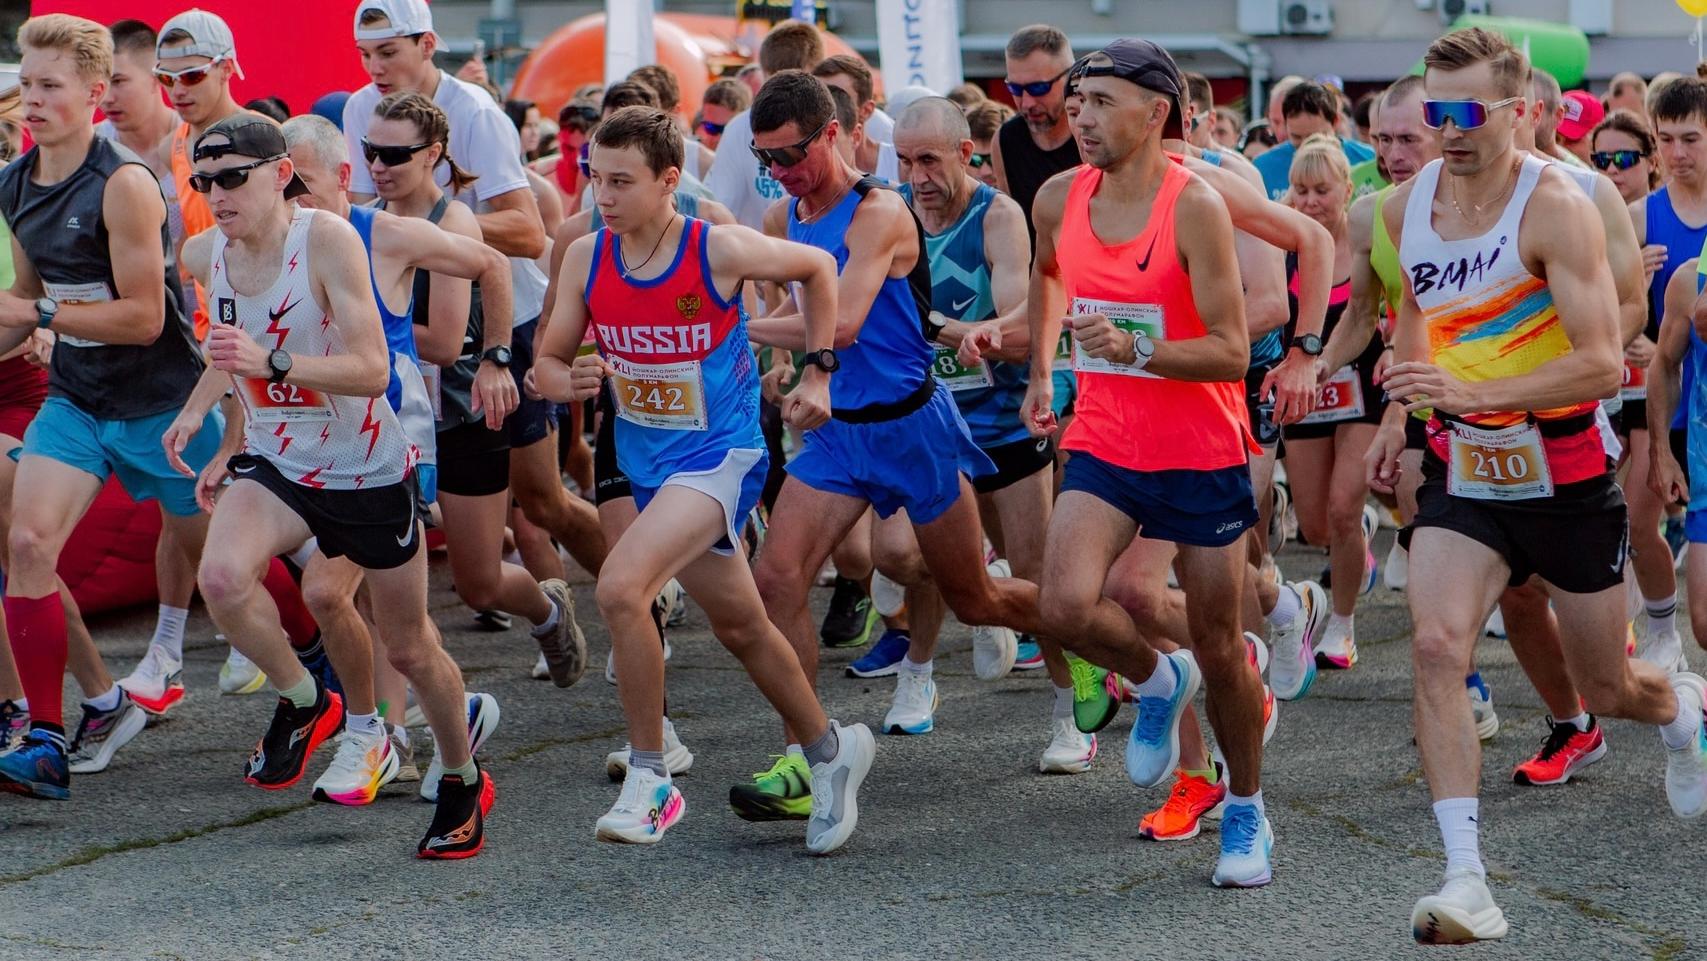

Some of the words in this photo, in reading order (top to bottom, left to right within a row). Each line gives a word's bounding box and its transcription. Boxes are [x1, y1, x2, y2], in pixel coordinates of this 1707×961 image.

[596, 322, 712, 354] RUSSIA
[267, 382, 304, 403] 62
[627, 385, 685, 411] 242
[1471, 451, 1528, 481] 210
